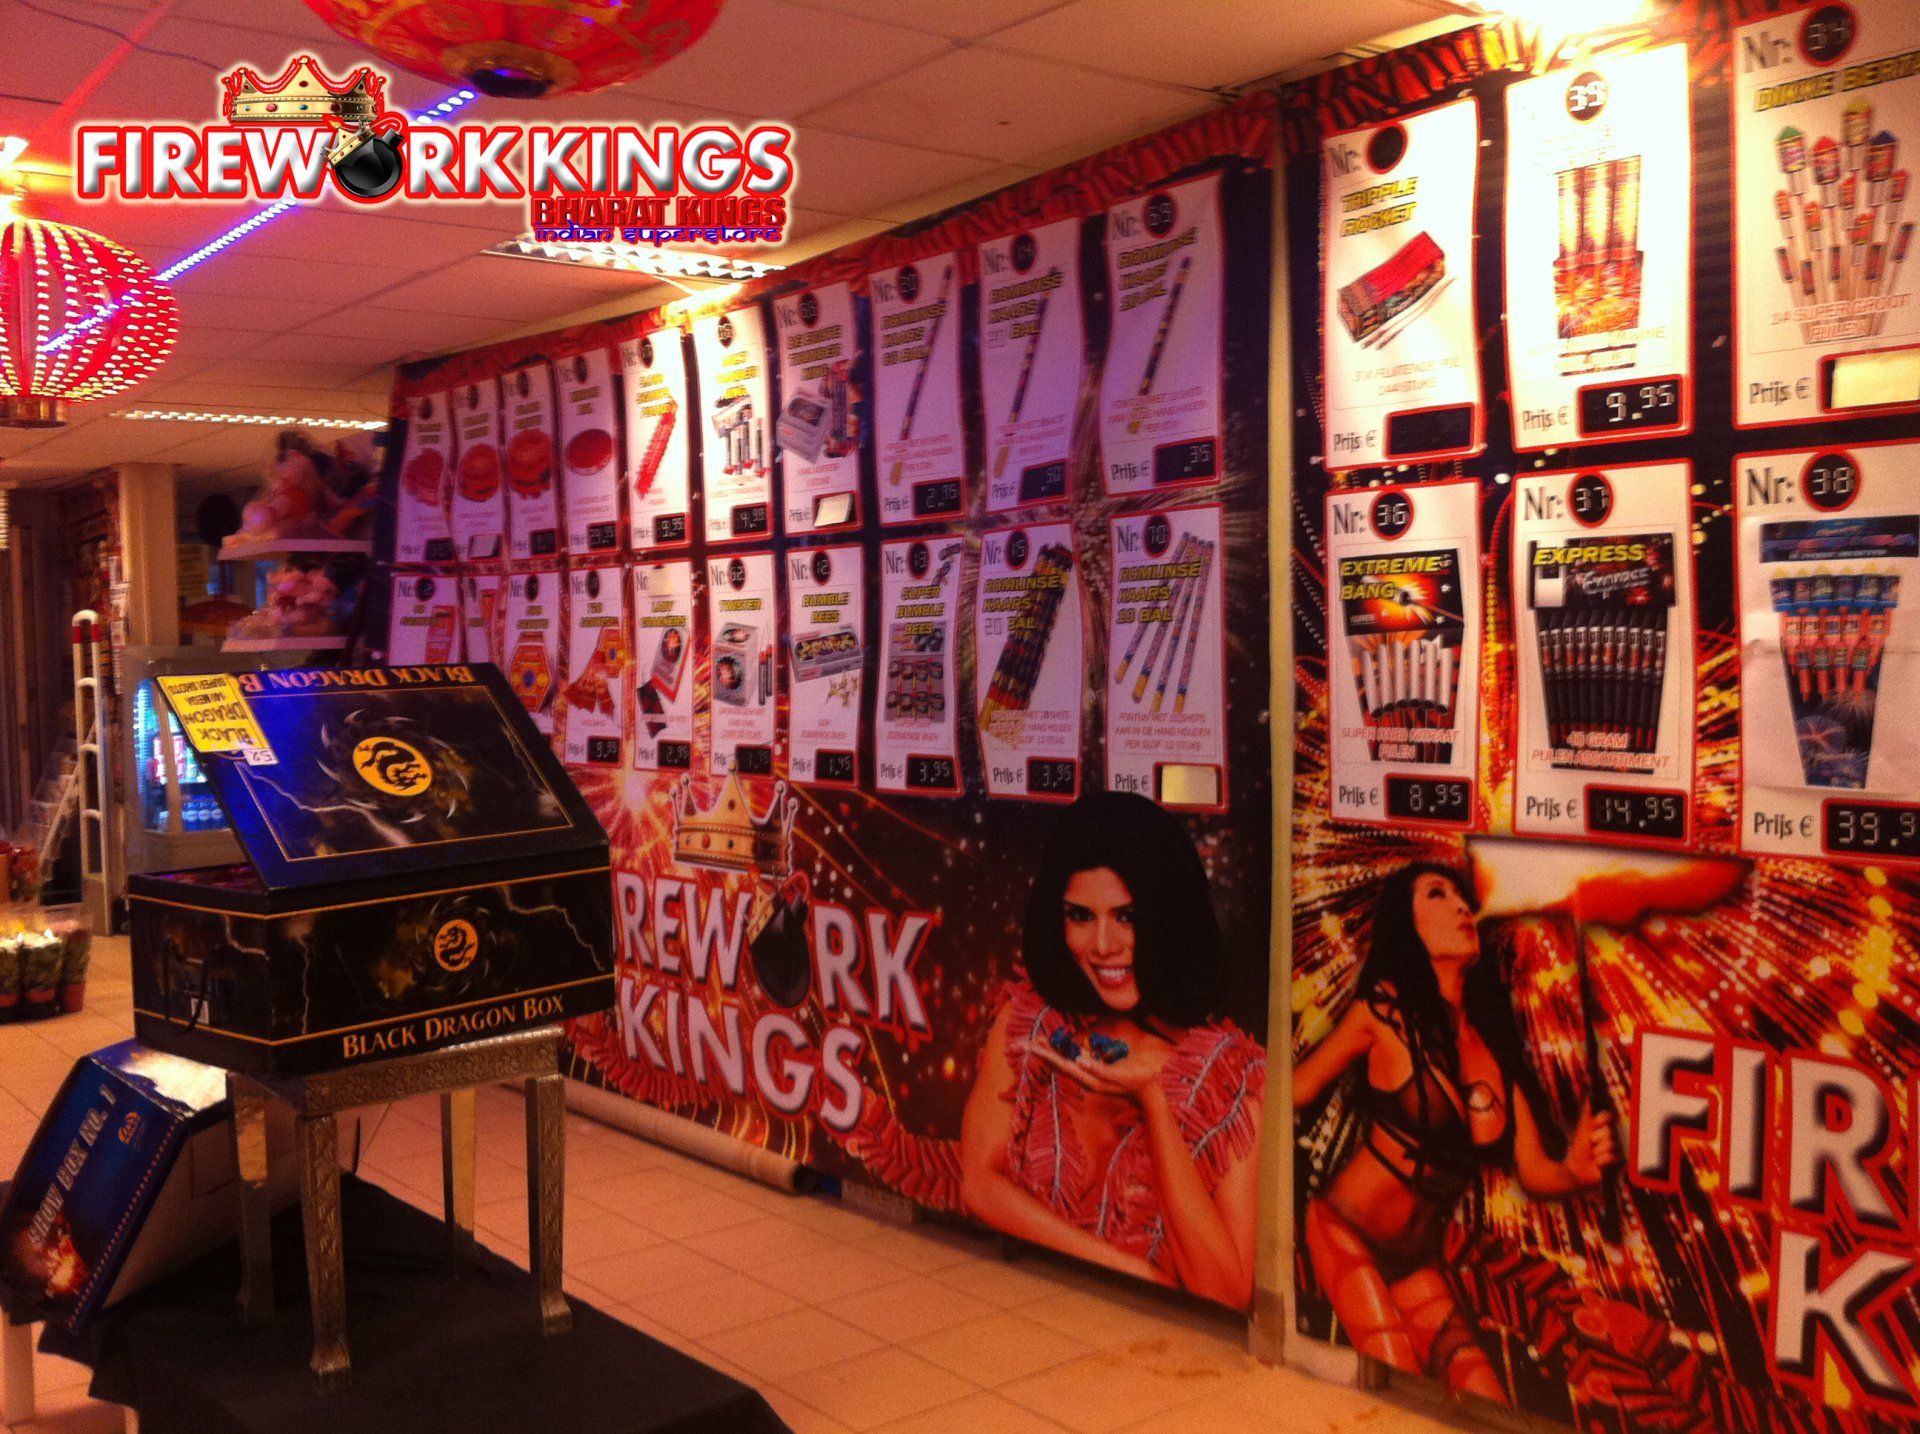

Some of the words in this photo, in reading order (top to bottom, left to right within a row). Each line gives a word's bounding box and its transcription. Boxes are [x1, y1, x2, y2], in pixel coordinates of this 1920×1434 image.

[1750, 379, 1790, 406] Prijs
[1795, 377, 1811, 400] €
[1522, 407, 1553, 432] Prijs
[1558, 405, 1568, 426] €
[1333, 432, 1361, 453] Prijs
[1366, 430, 1377, 448] €
[1111, 464, 1138, 481] Prijs
[1745, 467, 1794, 506] Nr:
[1812, 467, 1855, 495] 38
[1523, 486, 1563, 521] Nr:
[1574, 486, 1609, 513] 37
[1333, 503, 1363, 535] Nr:
[1377, 503, 1407, 527] 36
[1117, 525, 1140, 553] Nr:
[885, 551, 904, 575] Nr:
[1341, 556, 1441, 576] EXTREME
[1533, 543, 1645, 567] EXPRESS
[791, 559, 809, 581] Nr:
[901, 586, 941, 601] SUPER
[1117, 586, 1170, 605] KAARS
[1341, 580, 1396, 600] BANG
[1138, 606, 1172, 623] BAL
[183, 701, 248, 724] DRAGON
[197, 727, 253, 745] BLACK
[992, 767, 1014, 785] Prijs
[1115, 774, 1139, 793] Prijs
[1339, 784, 1366, 808] Prijs
[1370, 787, 1379, 805] €
[1409, 784, 1464, 814] 8.95
[1526, 795, 1560, 821] Prijs
[1566, 798, 1577, 819] €
[1604, 796, 1678, 829] 14.95
[1753, 811, 1793, 839] Prijs
[1799, 815, 1814, 839] €
[1838, 810, 1920, 847] 39.9
[620, 978, 863, 1131] KINGS
[1636, 1030, 1920, 1230] FIR
[56, 1138, 89, 1191] BOX
